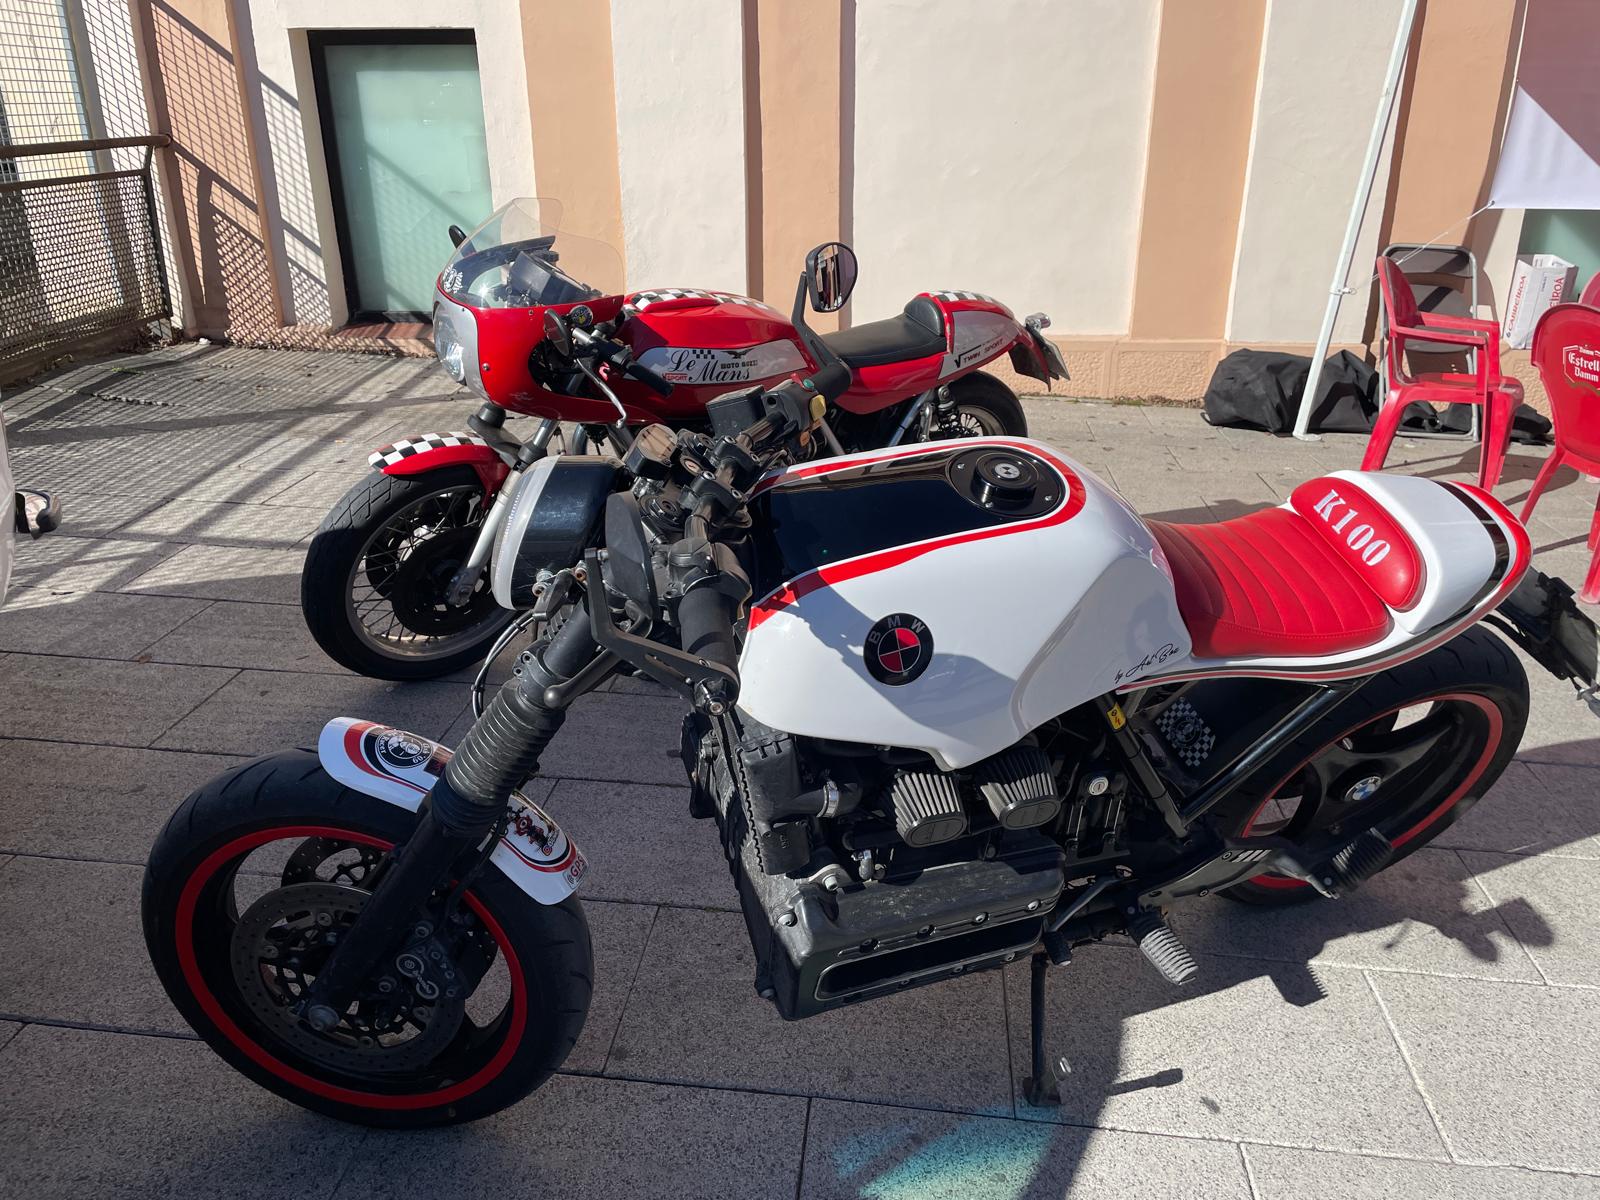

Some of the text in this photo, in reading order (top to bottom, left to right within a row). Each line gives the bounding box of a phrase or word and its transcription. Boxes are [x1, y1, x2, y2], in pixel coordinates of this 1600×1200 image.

[669, 349, 750, 383] Le Mans
[720, 362, 740, 370] MOTO
[1568, 351, 1600, 372] Estrell
[1574, 366, 1599, 383] Damm
[1313, 489, 1391, 567] K100
[868, 615, 926, 644] BMW
[570, 855, 586, 877] GPS
